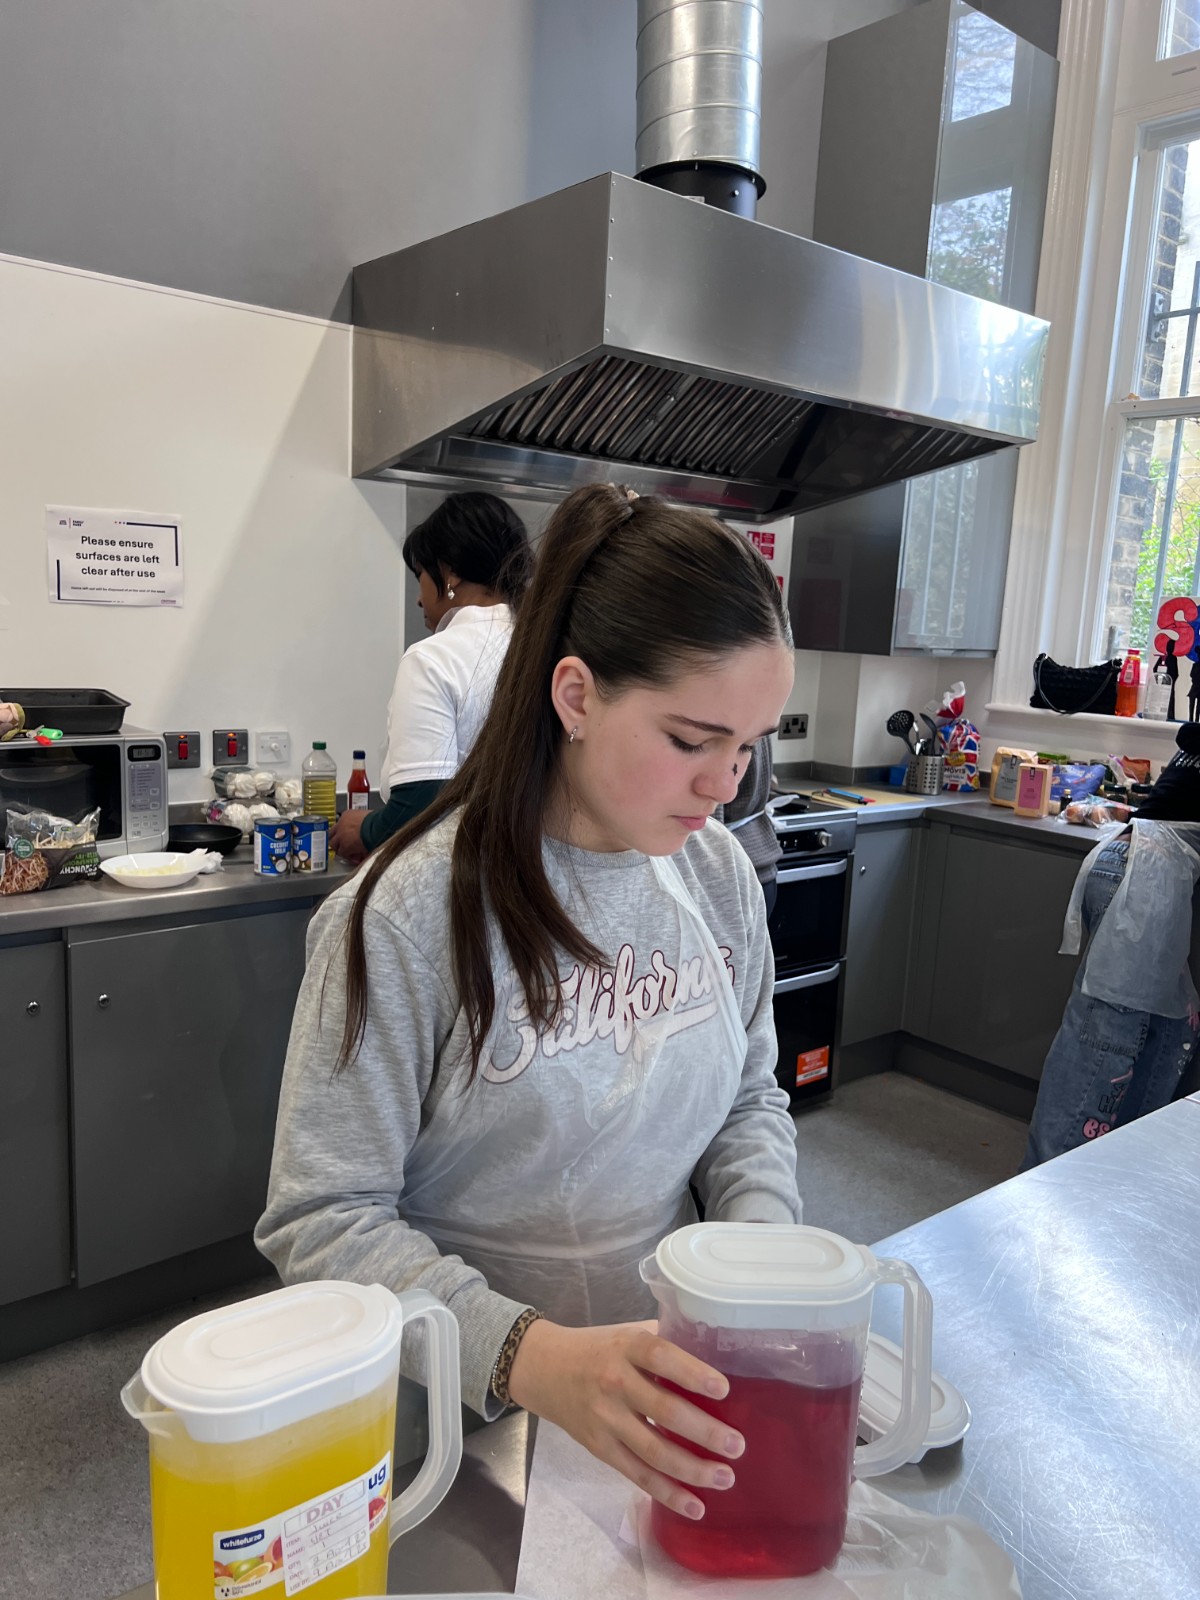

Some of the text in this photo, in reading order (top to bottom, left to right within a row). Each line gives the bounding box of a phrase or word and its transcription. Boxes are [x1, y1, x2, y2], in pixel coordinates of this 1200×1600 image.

[81, 535, 154, 549] Please ensure
[75, 551, 160, 564] surfaces are left
[81, 566, 156, 578] clear after use
[306, 1493, 344, 1524] DAY
[222, 1533, 262, 1548] whitefurze
